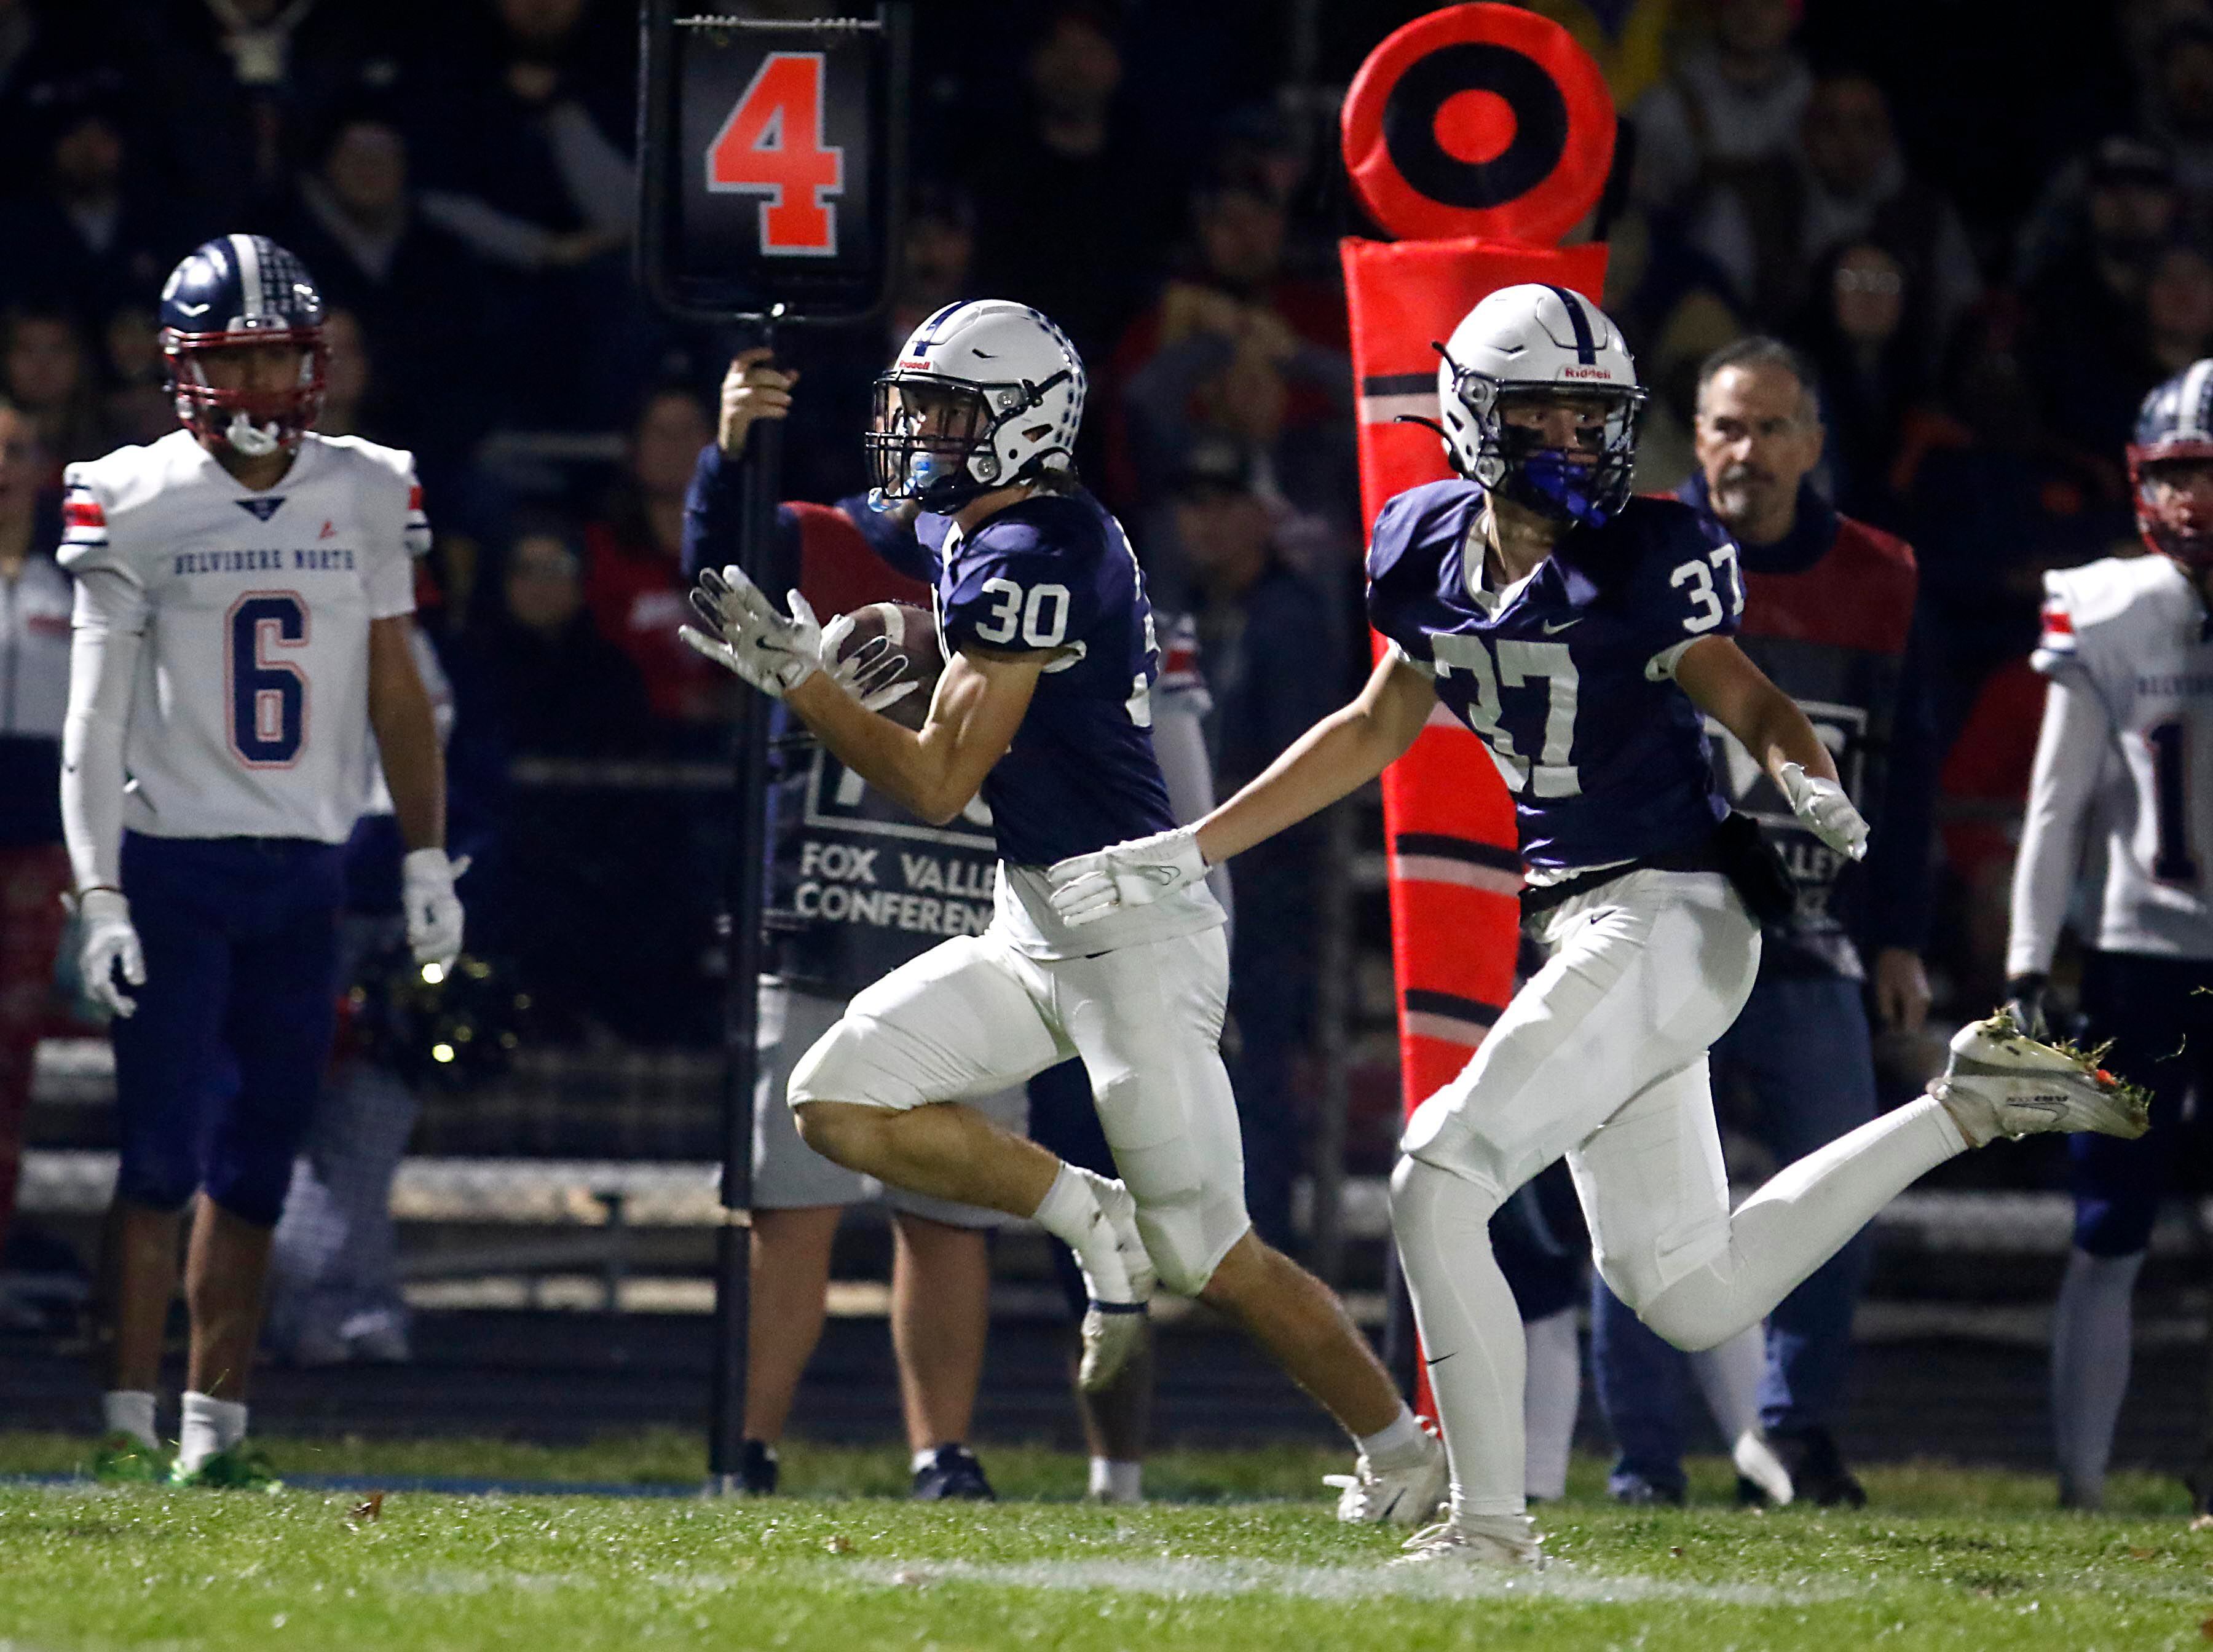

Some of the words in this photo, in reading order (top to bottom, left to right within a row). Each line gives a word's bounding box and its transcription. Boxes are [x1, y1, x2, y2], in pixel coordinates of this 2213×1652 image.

[706, 50, 845, 258] 4
[1565, 367, 1611, 379] Riddell
[175, 550, 282, 575] BELVIDERE
[294, 549, 355, 571] NORTH
[1669, 542, 1745, 633] 37
[975, 577, 1071, 647] 30
[224, 589, 312, 769] 6
[1431, 631, 1584, 799] 37
[800, 840, 880, 885] FOX
